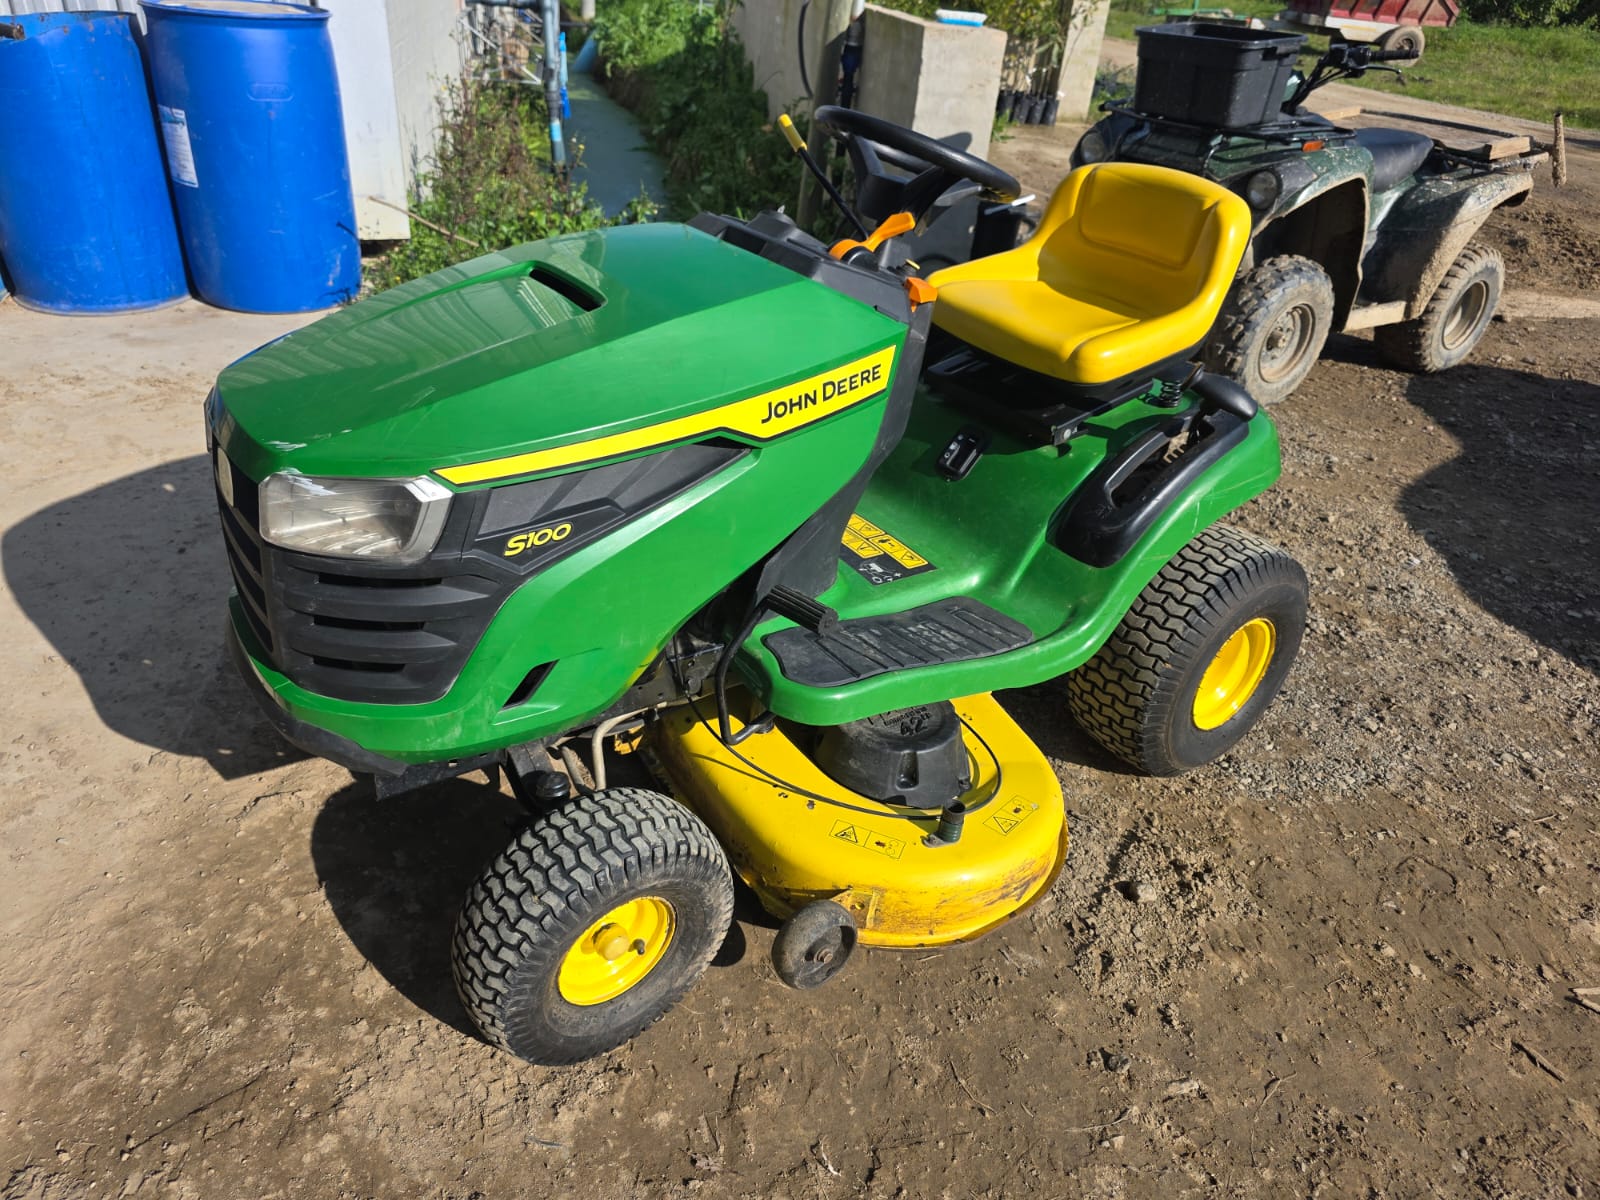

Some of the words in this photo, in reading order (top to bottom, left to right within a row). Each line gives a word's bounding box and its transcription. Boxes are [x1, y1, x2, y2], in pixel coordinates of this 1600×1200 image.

[761, 389, 817, 424] JOHN
[822, 363, 881, 402] DEERE
[503, 523, 572, 557] S100
